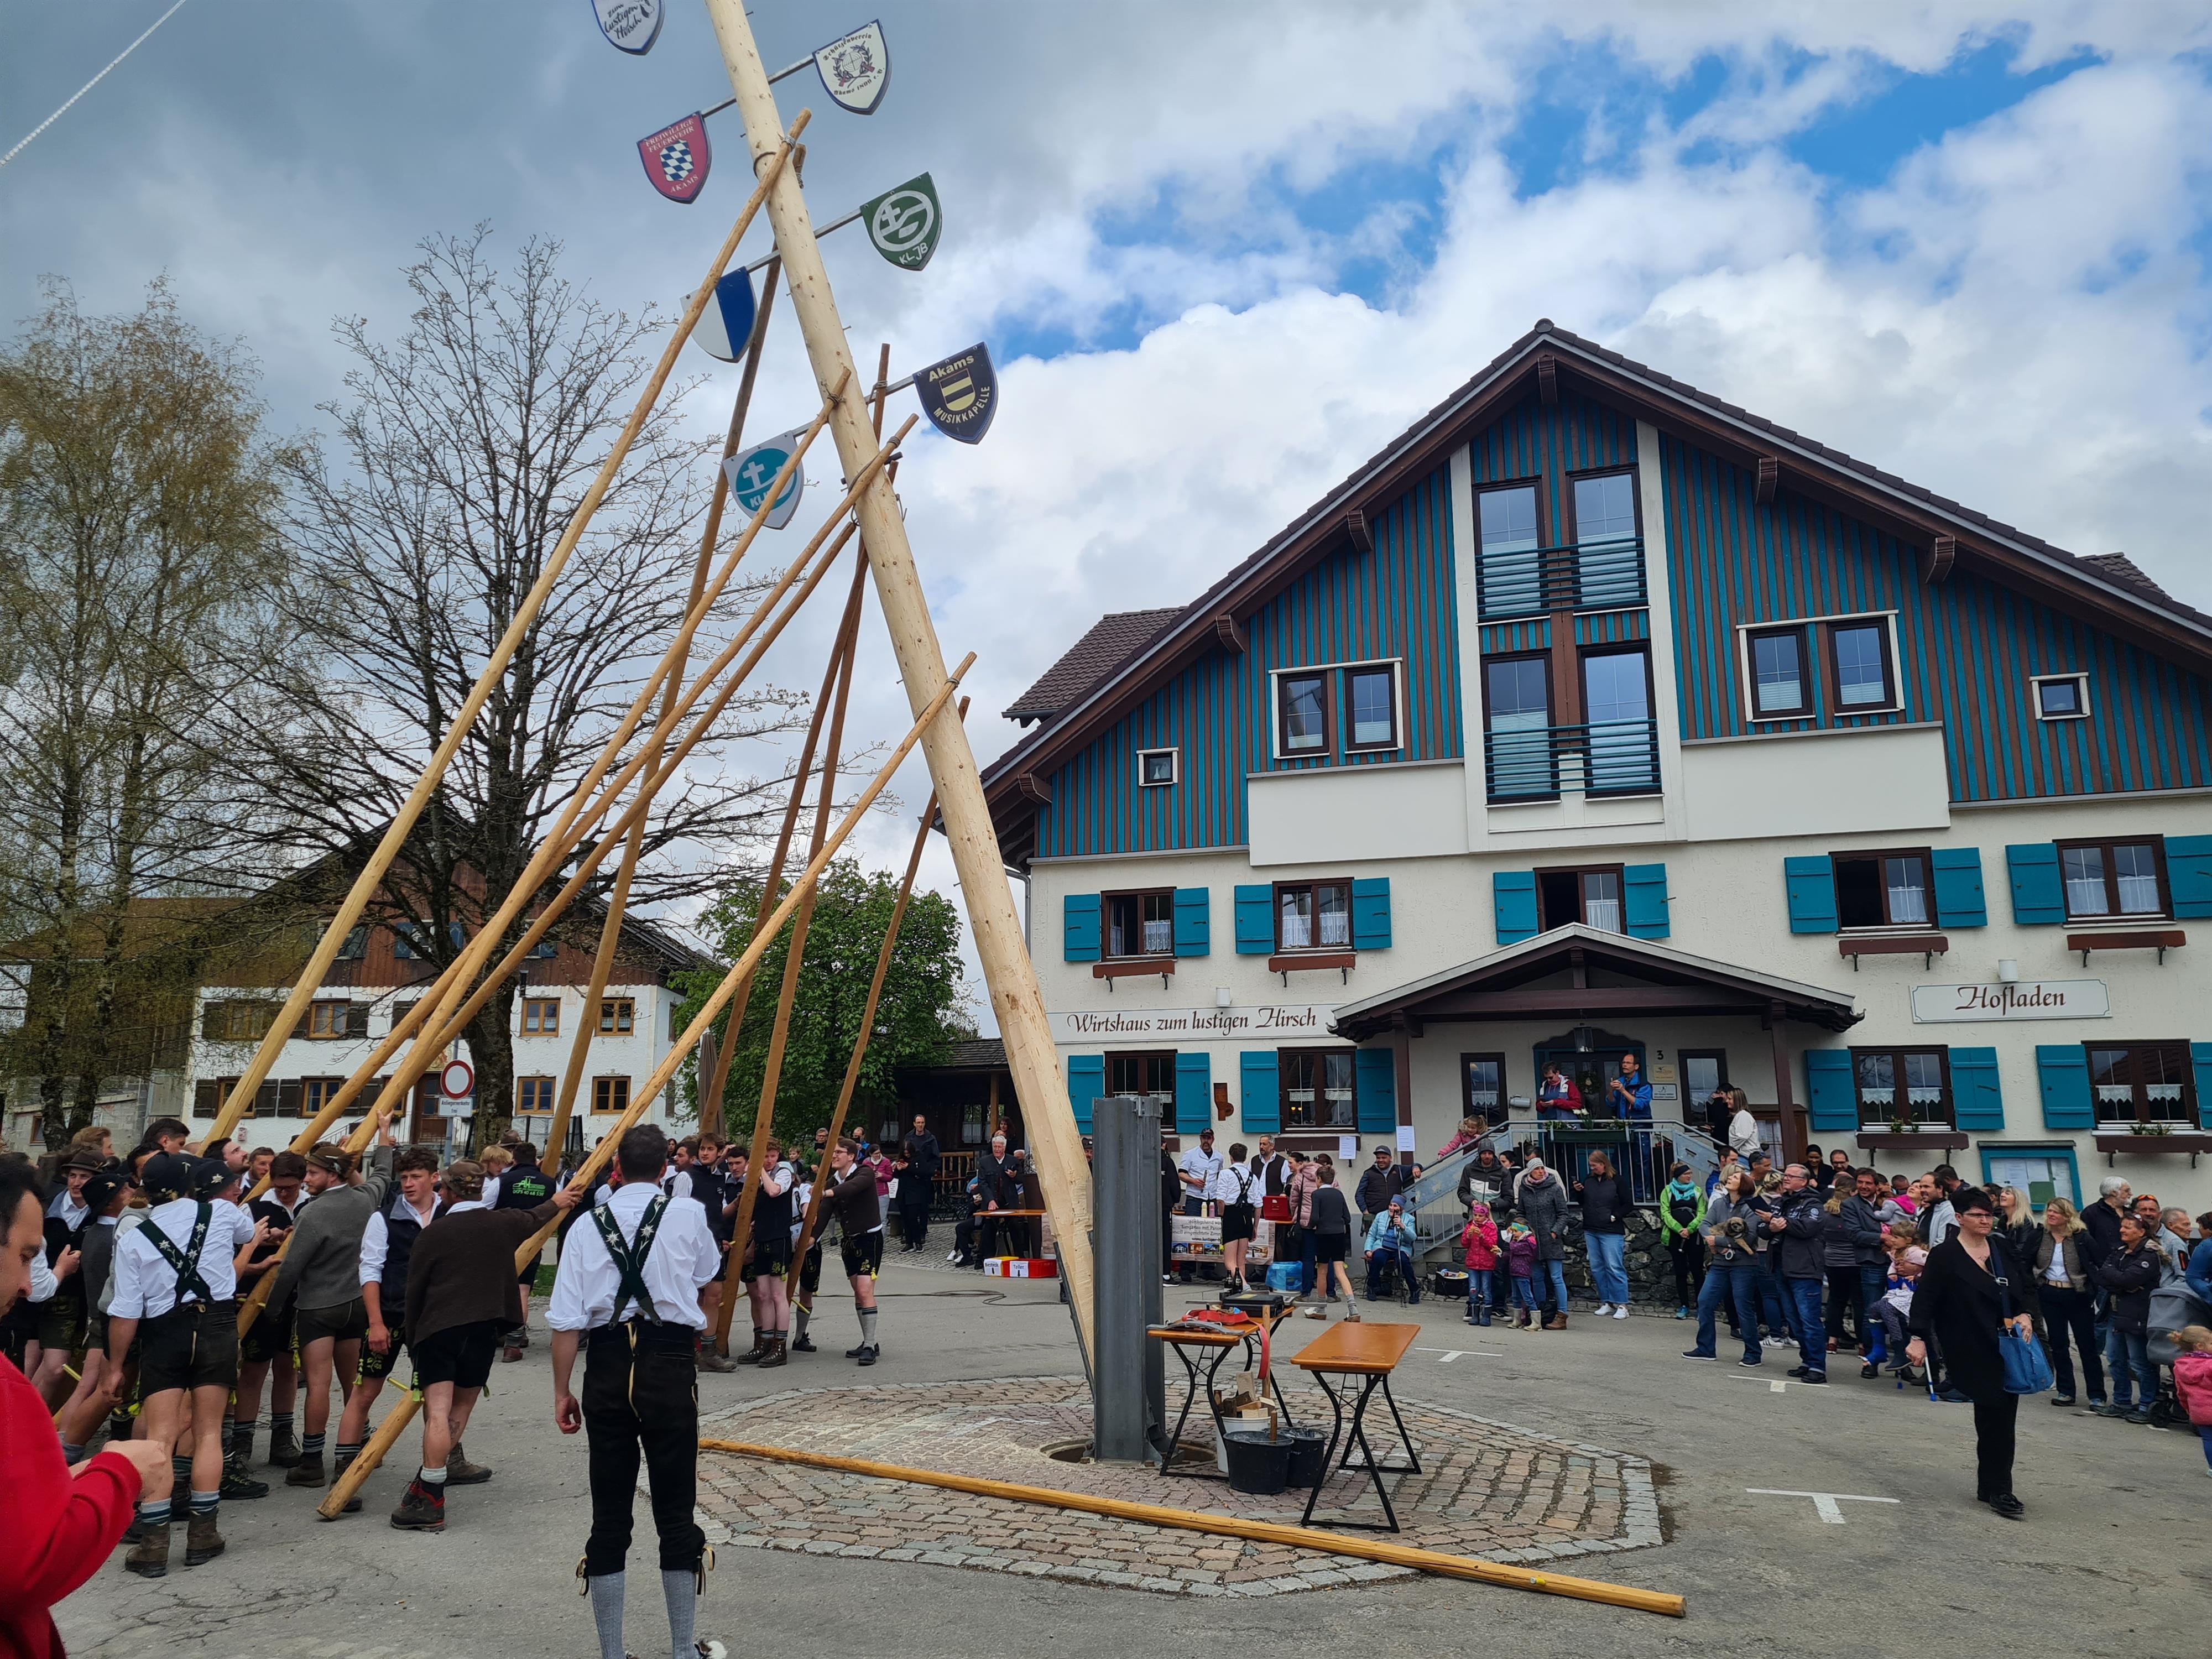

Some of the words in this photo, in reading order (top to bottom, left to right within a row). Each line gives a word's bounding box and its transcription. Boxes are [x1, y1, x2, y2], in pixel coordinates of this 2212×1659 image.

[823, 33, 872, 61] Schützenverein
[645, 118, 695, 147] FREIWILLIGE
[648, 126, 695, 153] FEUERWEHR
[670, 174, 699, 193] AKAMS
[899, 242, 928, 265] KLJB
[928, 355, 974, 382] Akams
[933, 386, 990, 424] MUSIKKAPELLE
[1955, 984, 2067, 1016] Hofladen
[1067, 1013, 1151, 1034] Wirtshaus
[1156, 1018, 1188, 1030] zum
[1192, 1011, 1249, 1036] lustigen
[1255, 1007, 1317, 1029] Hirsch
[1657, 1050, 1664, 1060] 3
